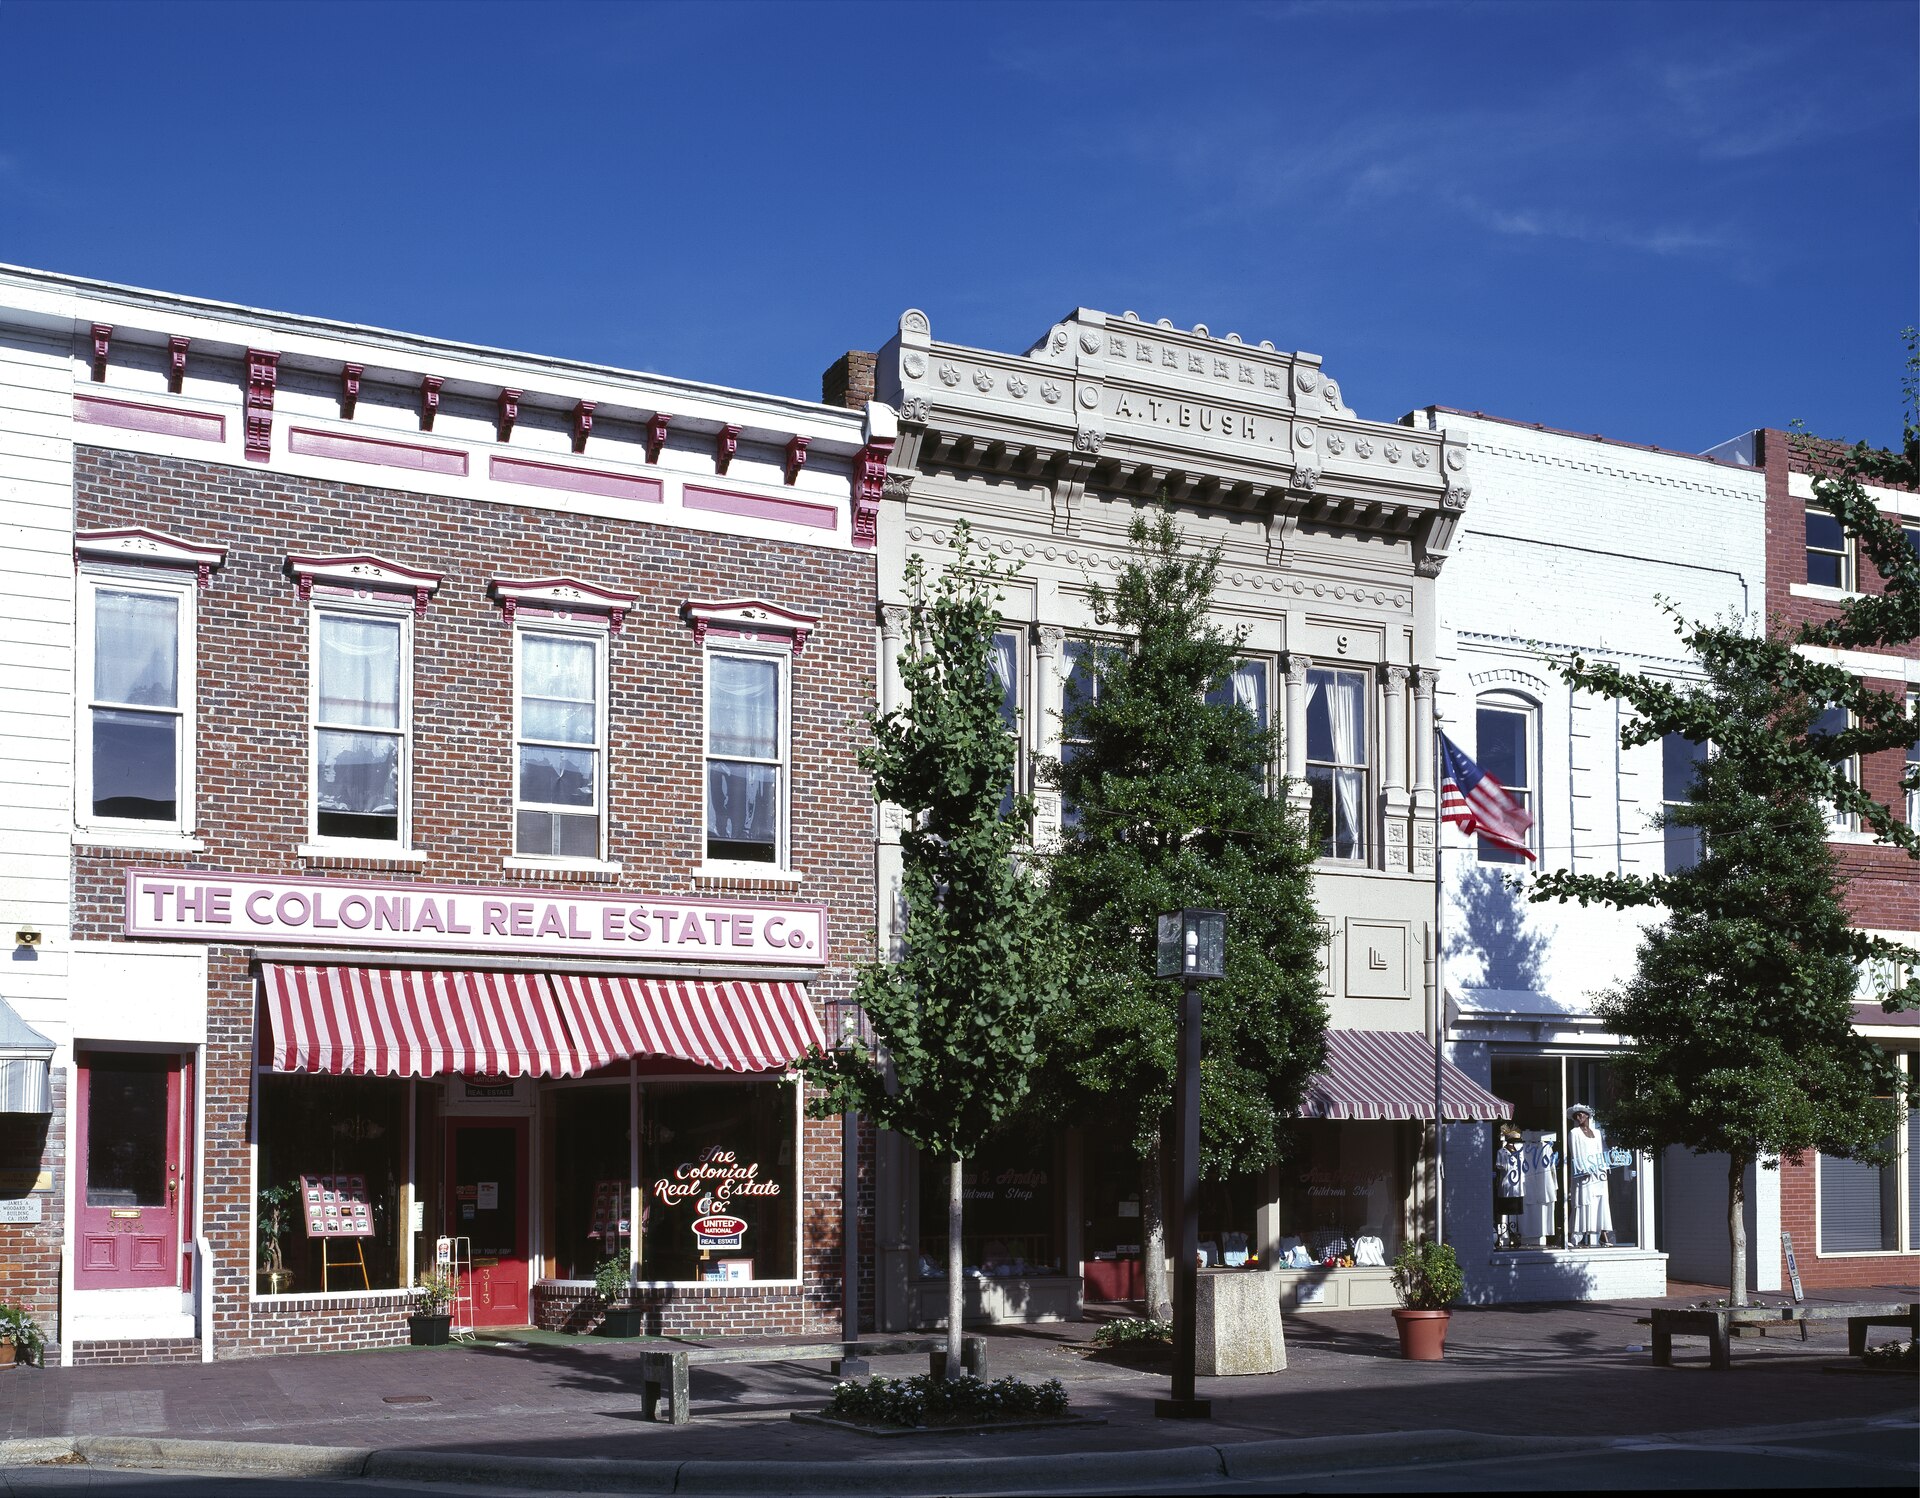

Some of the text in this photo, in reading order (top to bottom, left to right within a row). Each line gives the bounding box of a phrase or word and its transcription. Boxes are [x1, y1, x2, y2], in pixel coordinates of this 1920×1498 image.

[1337, 634, 1348, 655] 9
[143, 882, 814, 950] THE COLONIAL REAL ESTATE Co.
[674, 1162, 759, 1180] Colonial
[653, 1178, 781, 1206] Real Estate
[1005, 1186, 1034, 1201] Shop
[1352, 1185, 1376, 1198] Shop
[703, 1220, 735, 1228] UNITED
[482, 1269, 491, 1305] 313
